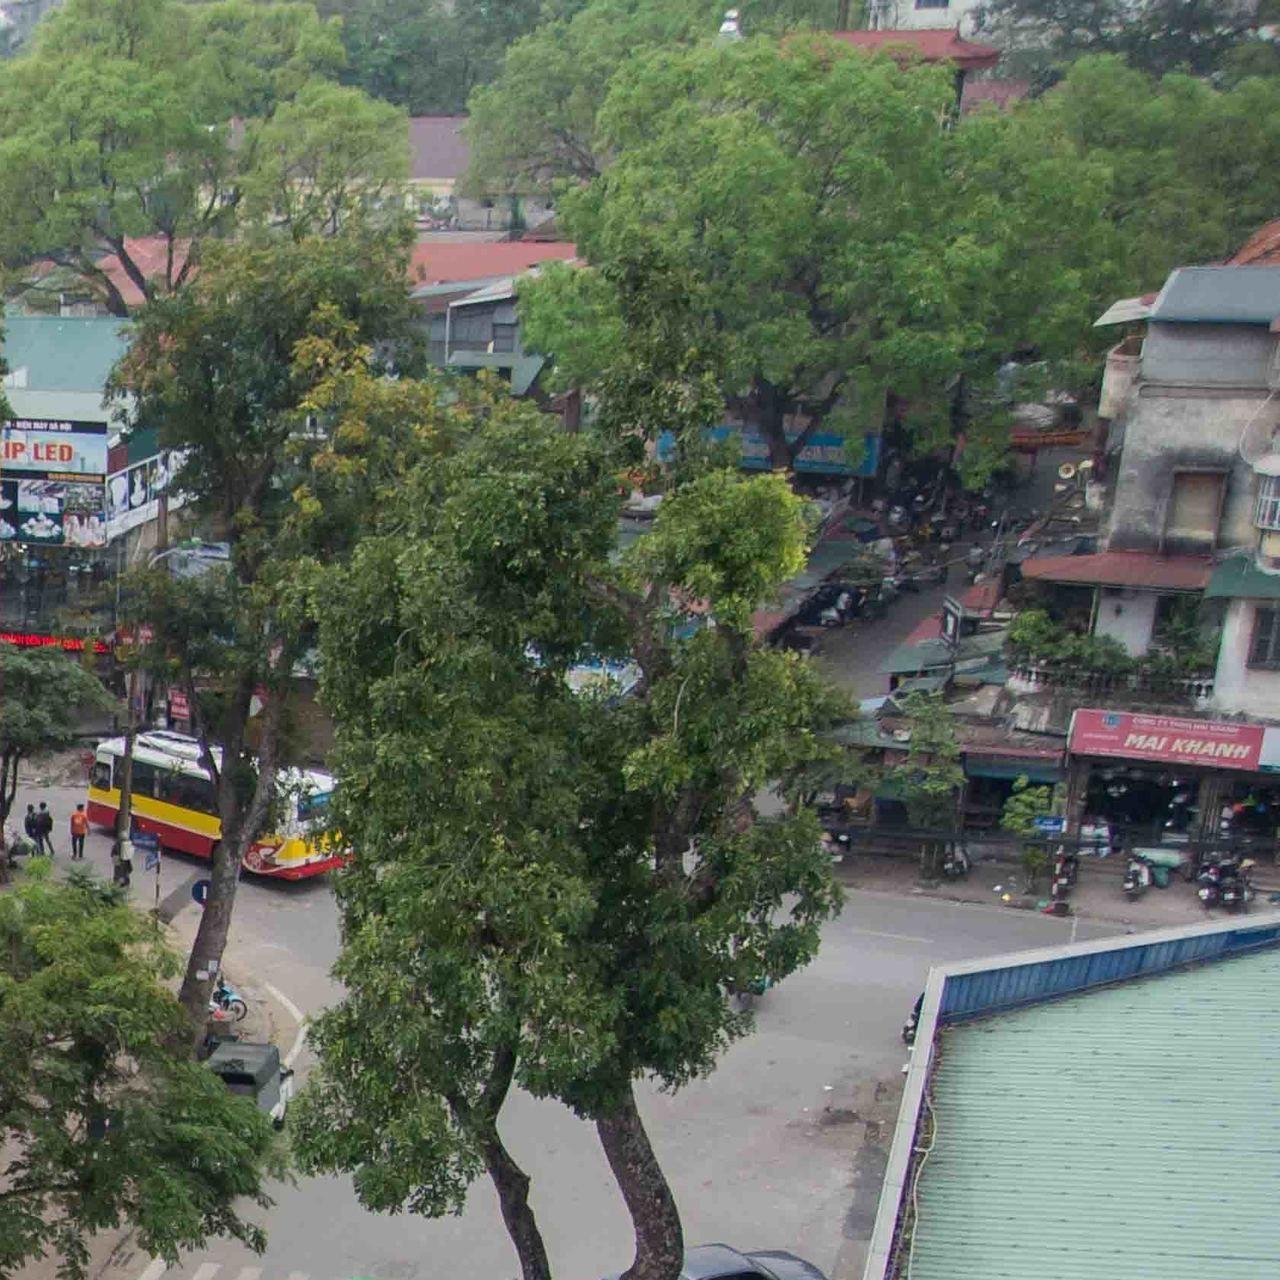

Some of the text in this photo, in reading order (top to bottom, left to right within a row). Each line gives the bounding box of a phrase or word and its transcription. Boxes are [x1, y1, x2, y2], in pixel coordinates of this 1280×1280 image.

[33, 443, 72, 462] LED
[1123, 732, 1168, 750] MAI
[1170, 738, 1251, 759] KHANH
